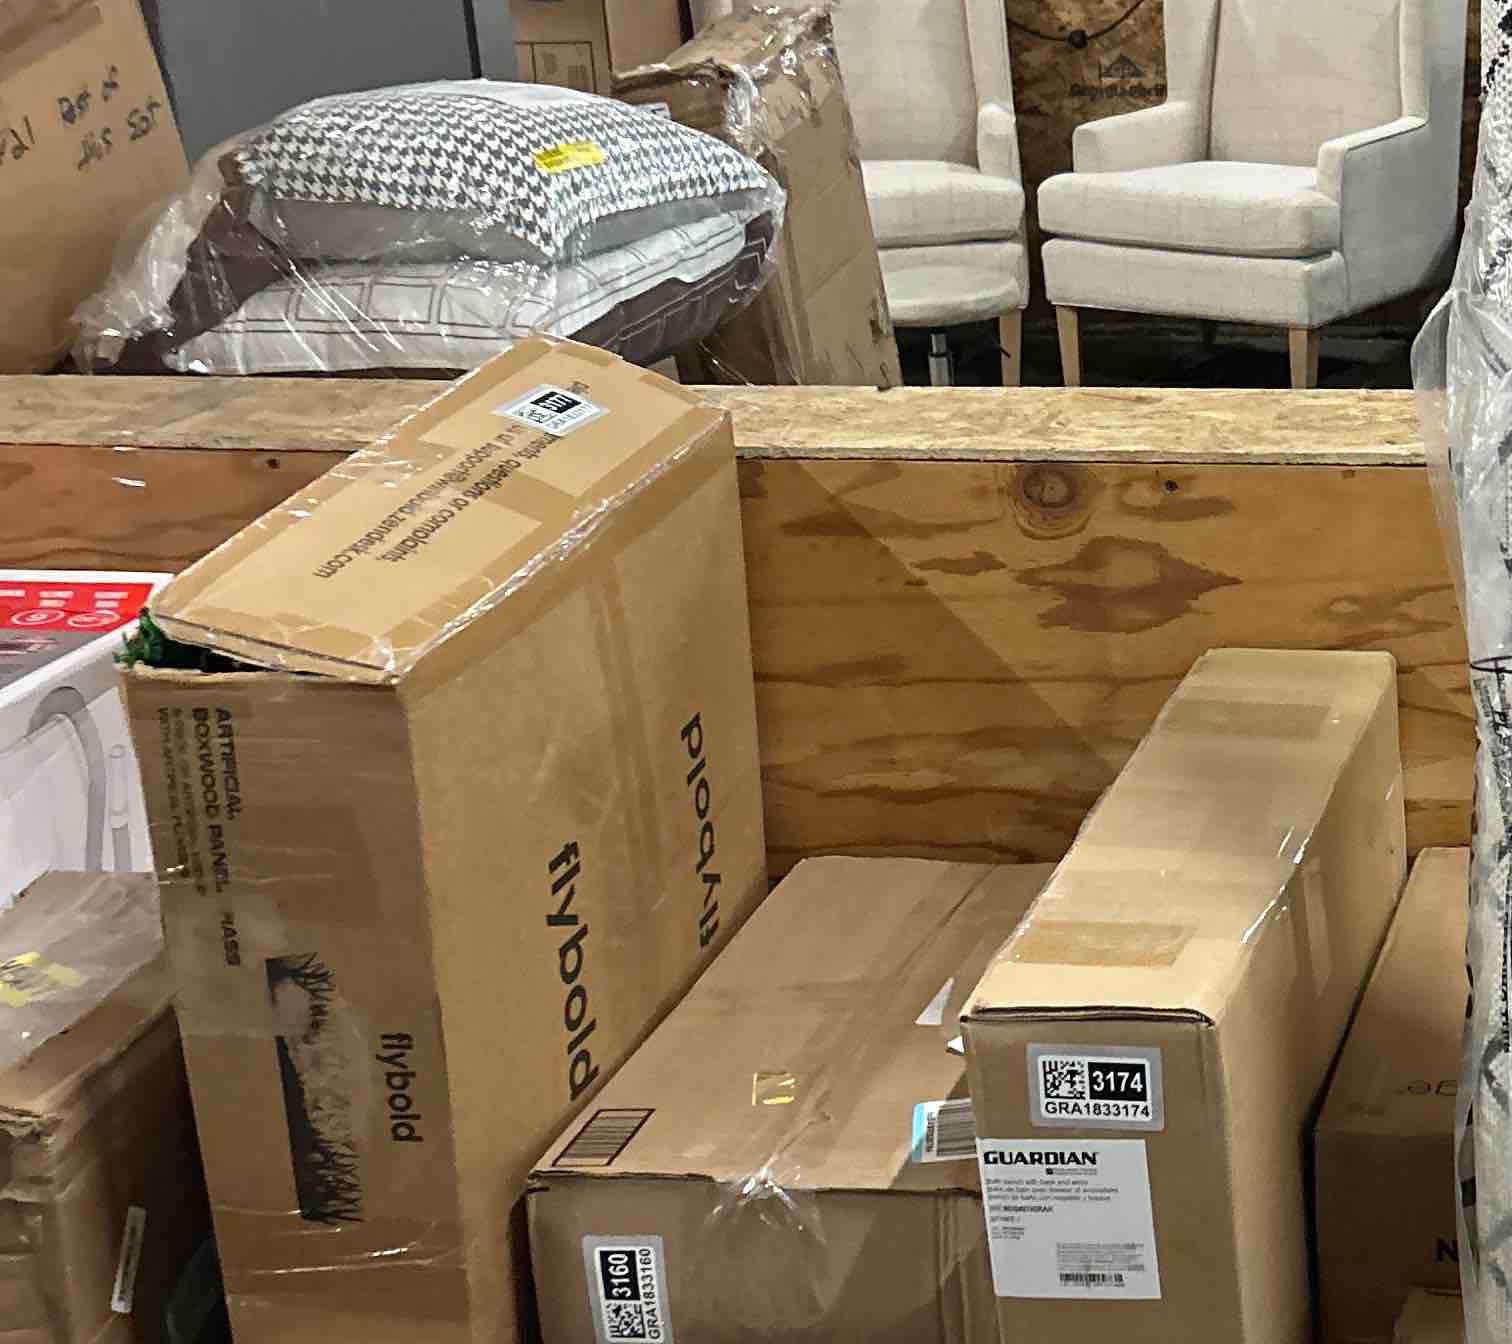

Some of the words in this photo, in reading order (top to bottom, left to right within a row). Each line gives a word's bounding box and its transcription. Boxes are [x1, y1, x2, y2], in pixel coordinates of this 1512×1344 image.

[190, 707, 219, 819] BOXWOOD
[545, 837, 600, 1102] flybold
[374, 1031, 425, 1143] flybold
[1044, 1101, 1151, 1118] GRA1833174
[1092, 1070, 1144, 1094] 3174
[983, 1151, 1098, 1166] GUARDIAN
[607, 1253, 632, 1298] 3160
[638, 1248, 661, 1340] GRA1833160
